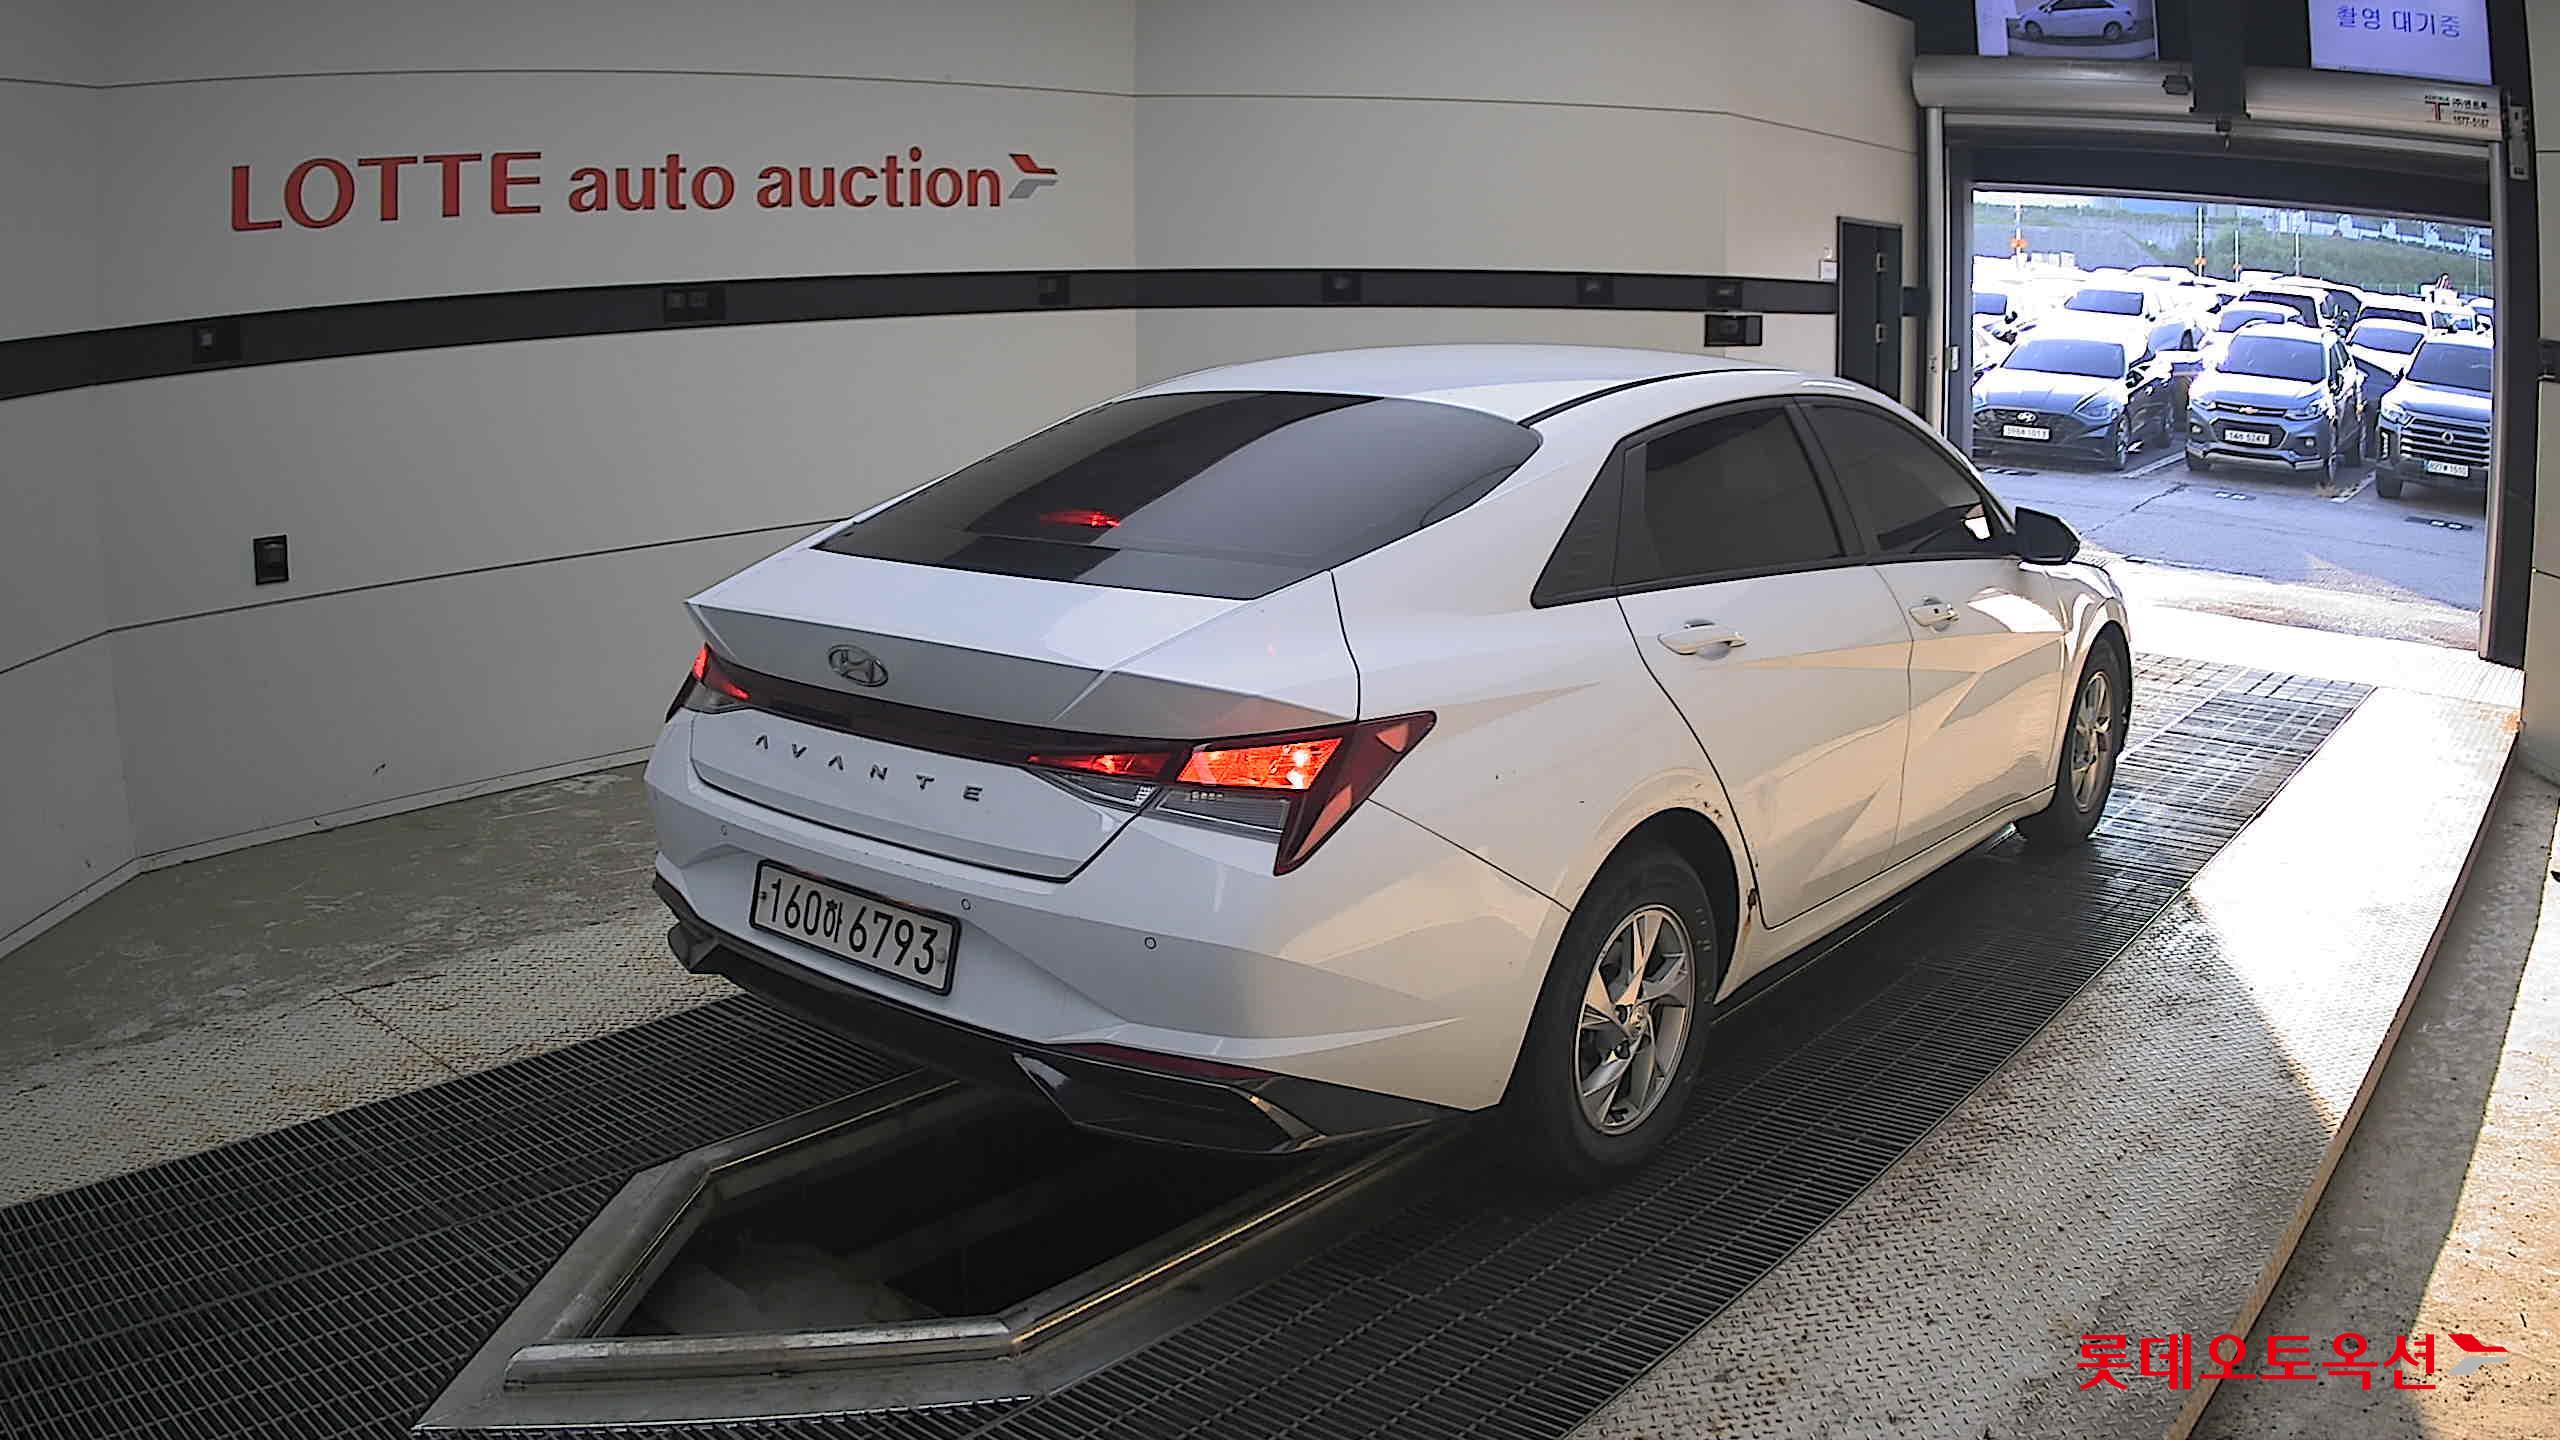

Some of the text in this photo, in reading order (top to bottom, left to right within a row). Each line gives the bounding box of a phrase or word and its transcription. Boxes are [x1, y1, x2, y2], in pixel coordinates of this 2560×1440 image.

[2336, 6, 2460, 38] 촬영 대기중
[231, 146, 1002, 232] LOTTE auto auction
[755, 734, 984, 802] AVANTE
